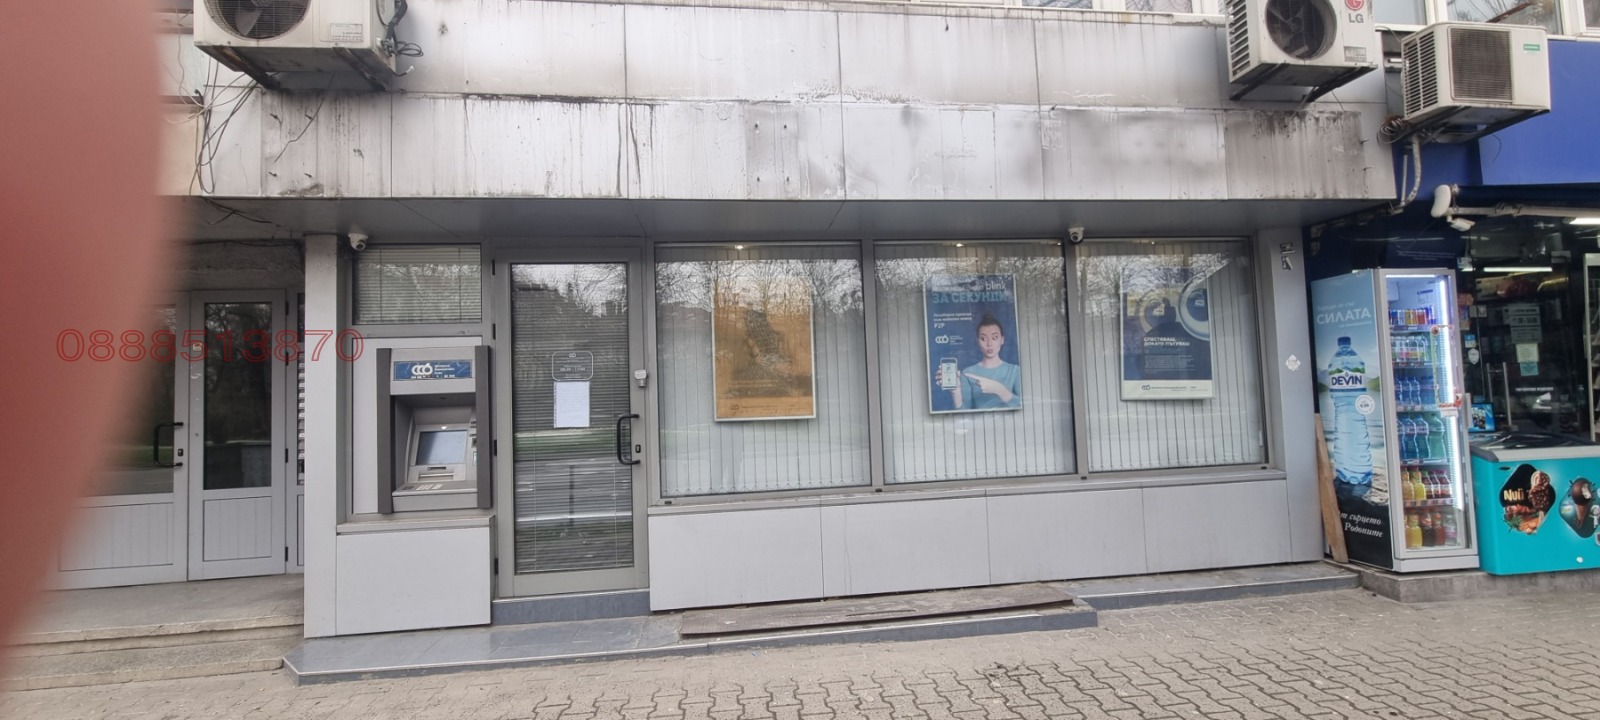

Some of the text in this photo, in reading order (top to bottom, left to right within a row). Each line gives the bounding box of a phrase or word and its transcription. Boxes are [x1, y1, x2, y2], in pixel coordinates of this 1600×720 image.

[1348, 13, 1364, 23] LG
[985, 281, 1006, 290] blink
[932, 291, 1008, 303] ЗА СЕКУНДИ
[1316, 308, 1371, 324] СИЛАТА
[1331, 375, 1363, 386] DEVIN
[1349, 514, 1381, 525] сърцето
[1344, 522, 1383, 538] Родопите
